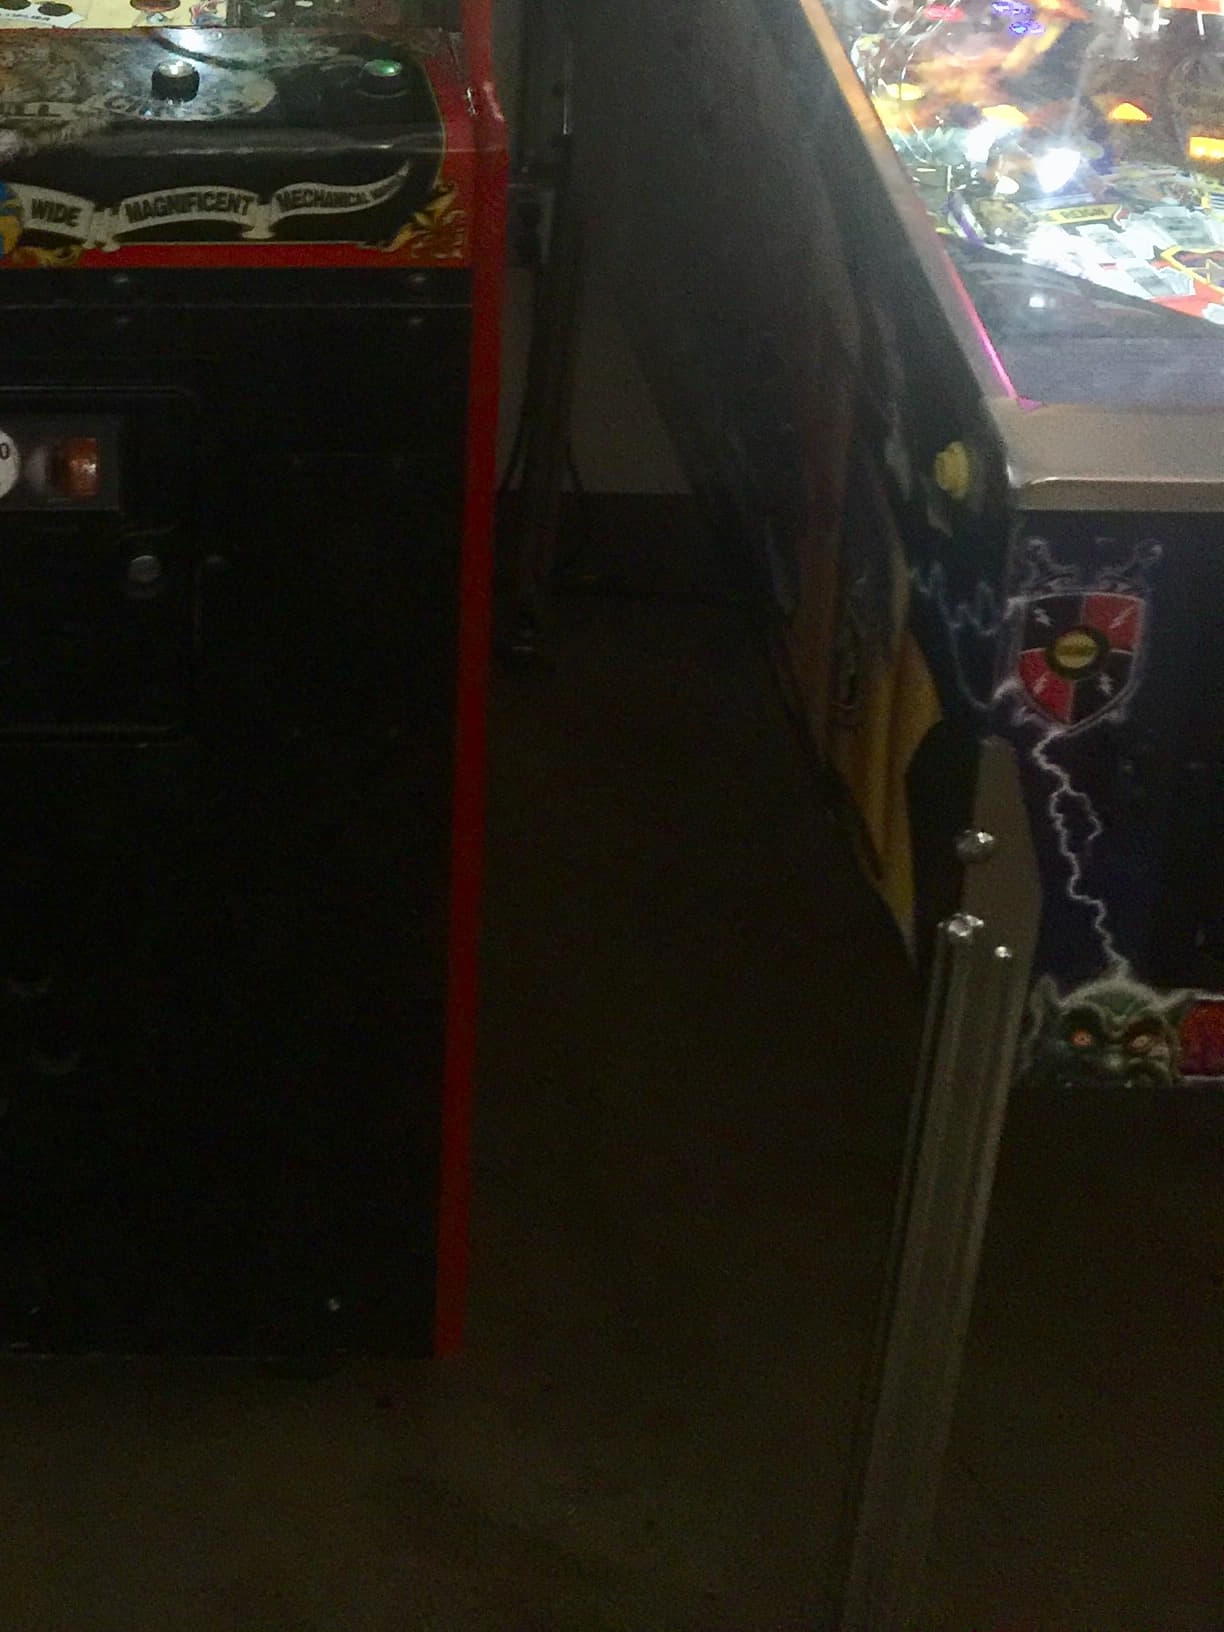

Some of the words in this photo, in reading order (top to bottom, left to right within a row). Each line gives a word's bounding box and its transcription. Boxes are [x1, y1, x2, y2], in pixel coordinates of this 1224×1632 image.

[30, 196, 83, 228] WIDE
[124, 190, 255, 224] MAGNIFICENT
[275, 188, 373, 211] MECHANICAL
